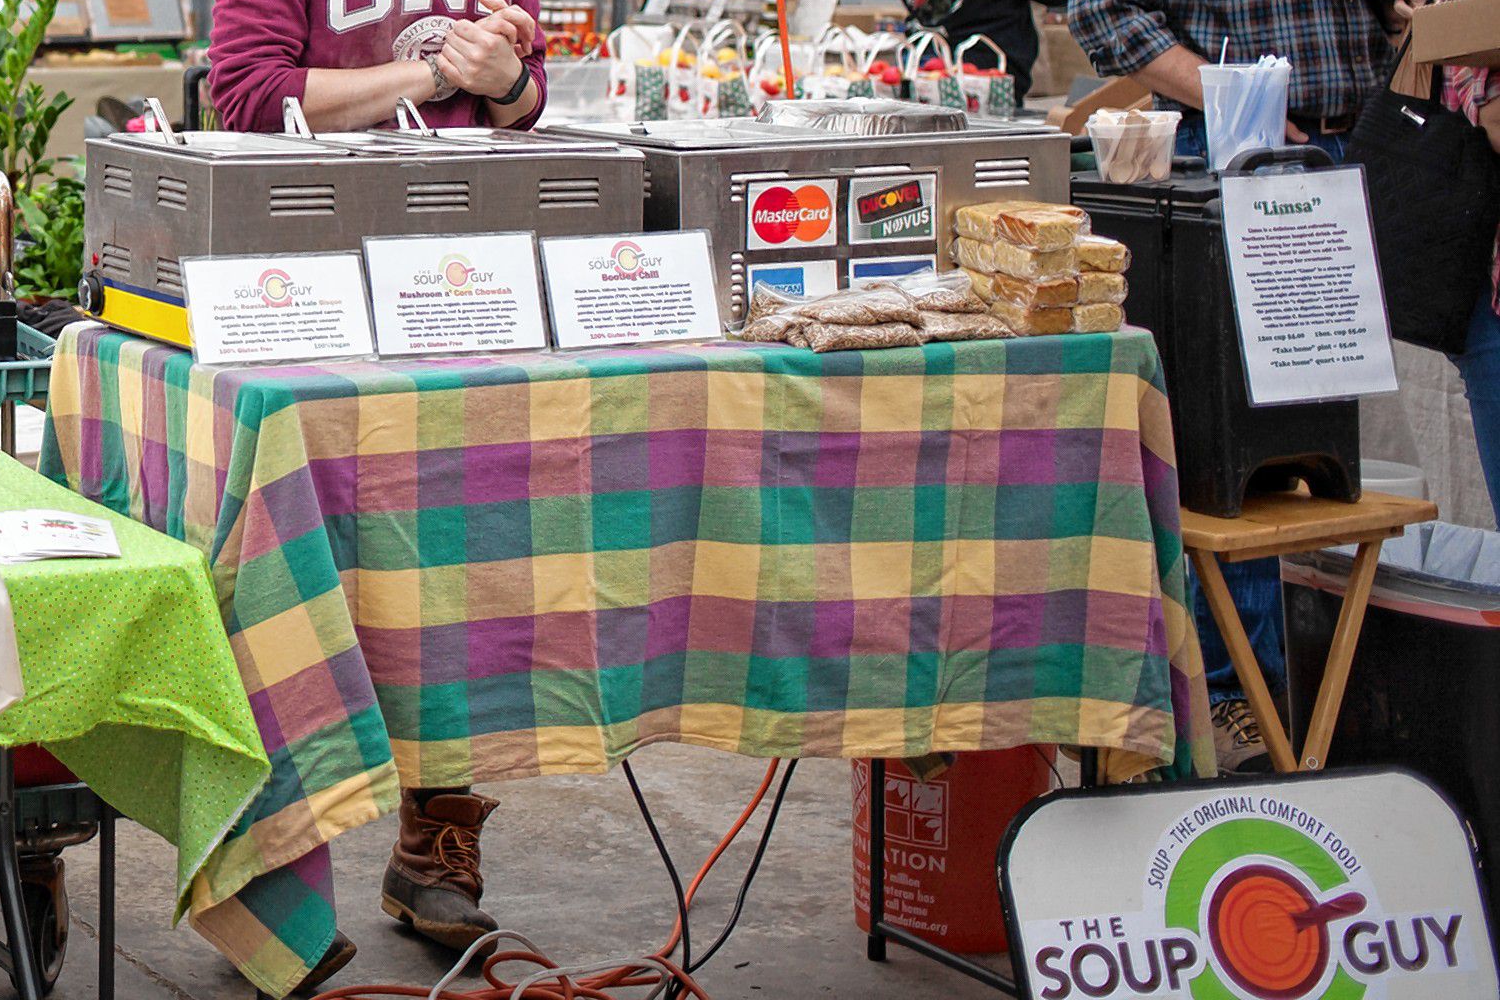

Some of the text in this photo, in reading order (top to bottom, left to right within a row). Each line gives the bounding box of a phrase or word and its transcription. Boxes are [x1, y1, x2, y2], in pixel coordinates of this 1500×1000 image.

[861, 184, 919, 215] DISCOVER
[754, 207, 830, 224] MasterCard
[883, 209, 930, 236] NOVUS
[588, 257, 662, 270] SOUP GUY
[413, 271, 494, 286] SOUP GUY
[602, 272, 637, 281] Bootleg
[234, 285, 312, 299] SOUP GUY
[399, 291, 443, 299] Mushroom
[1148, 849, 1171, 890] SOUP
[1169, 816, 1197, 844] THE
[1193, 796, 1256, 827] ORIGINAL
[1260, 797, 1325, 837] COMFORT
[1323, 831, 1362, 876] FOOD!
[917, 889, 936, 904] has
[902, 900, 929, 916] home
[1060, 916, 1125, 941] THE
[1035, 913, 1463, 1000] SOUP GUY
